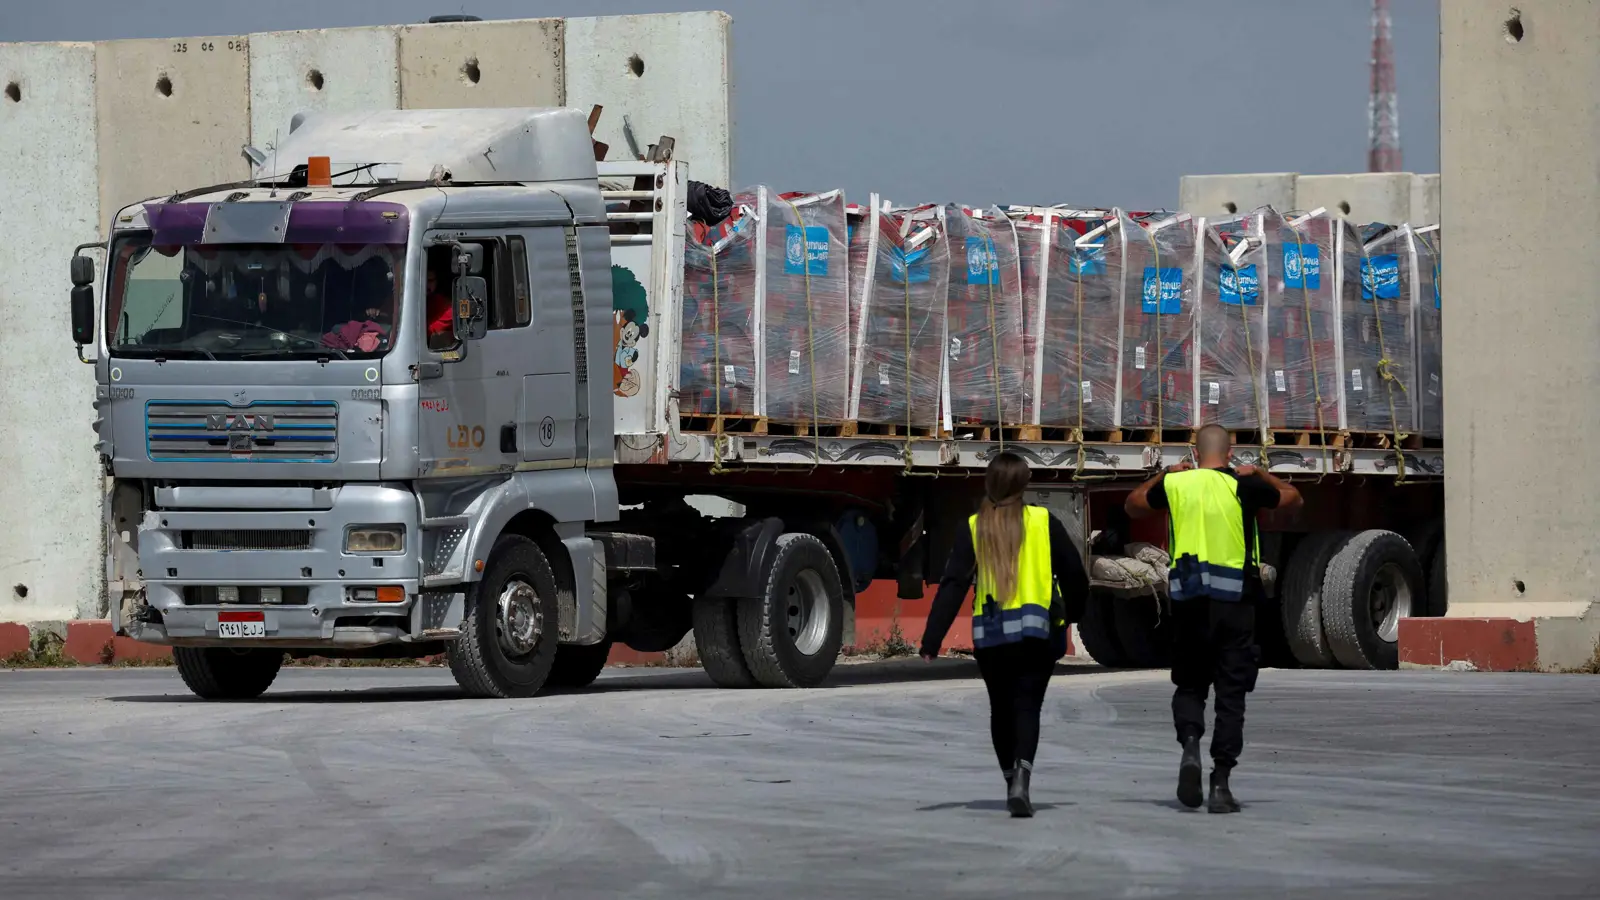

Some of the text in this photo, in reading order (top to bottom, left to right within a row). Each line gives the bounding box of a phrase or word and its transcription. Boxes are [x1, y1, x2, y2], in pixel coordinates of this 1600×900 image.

[201, 42, 214, 51] 06
[206, 414, 275, 432] MAN
[541, 423, 553, 440] 18
